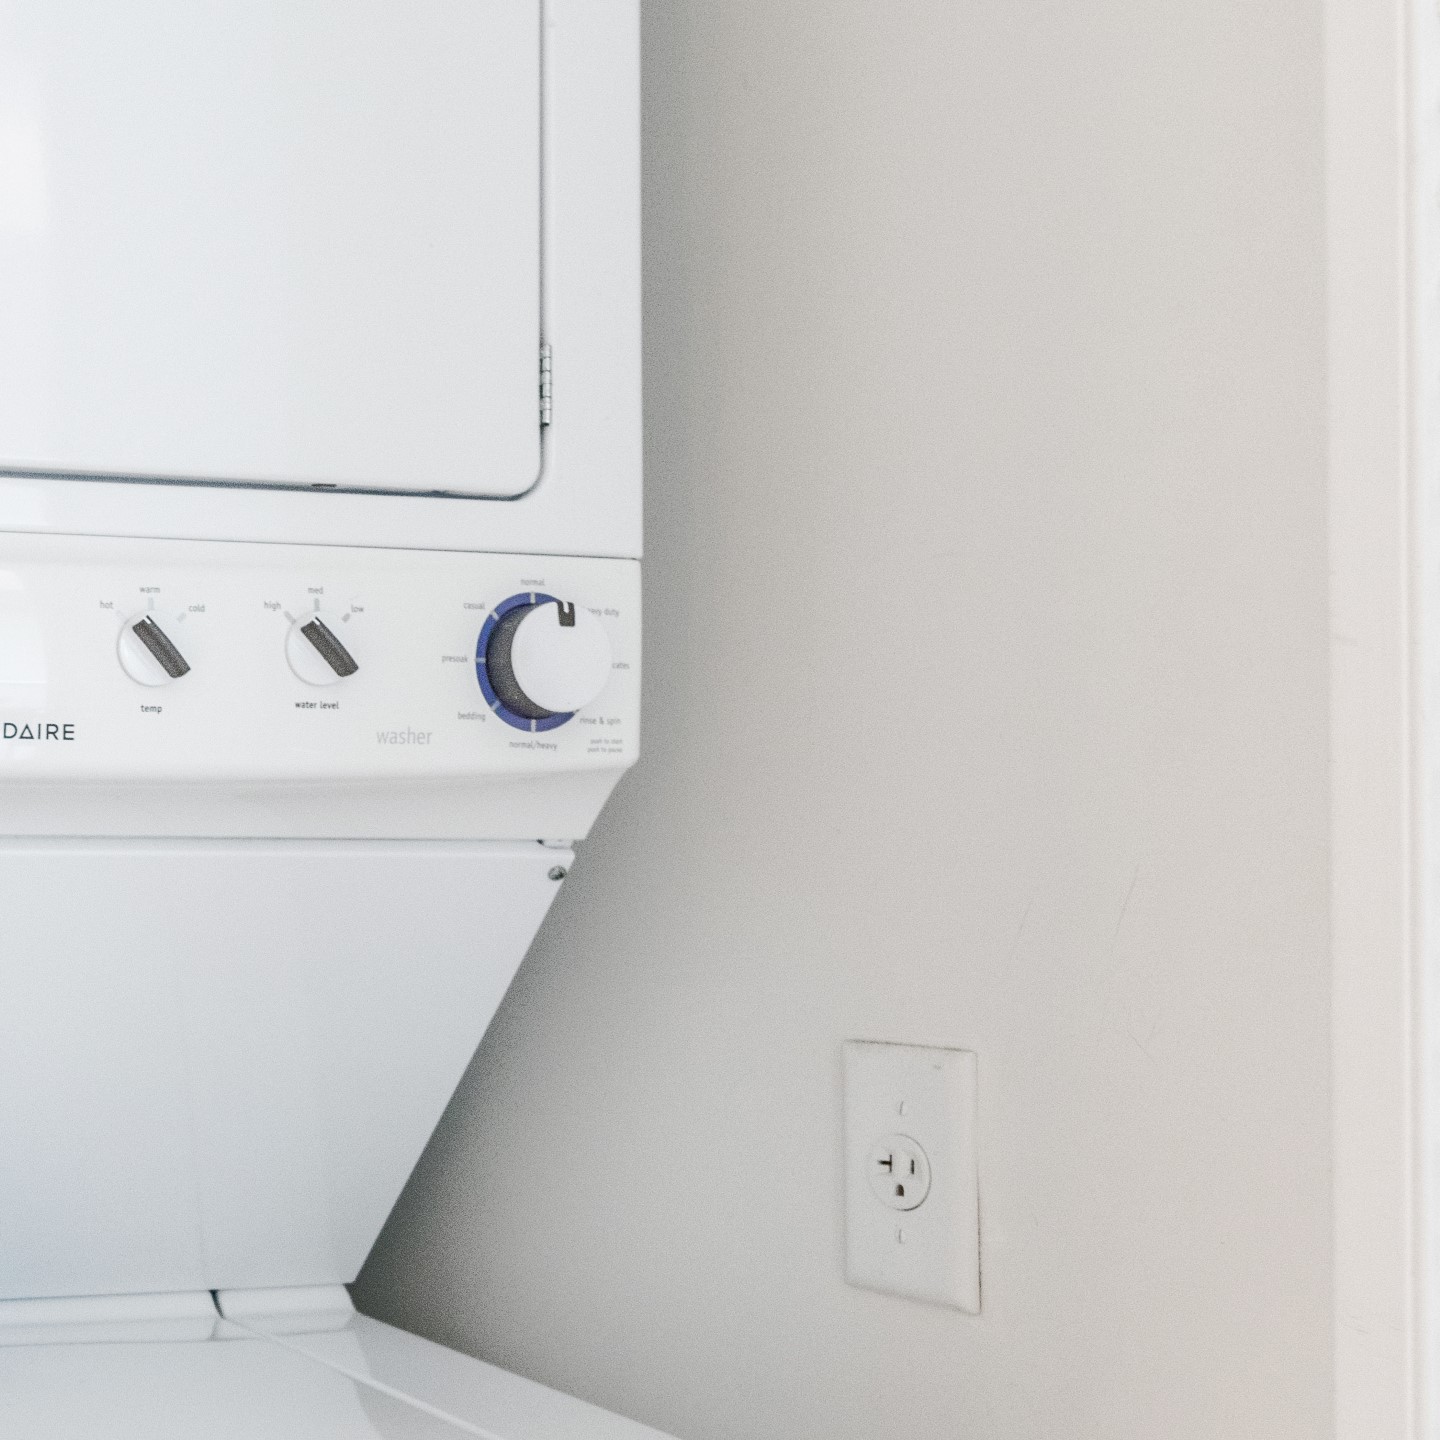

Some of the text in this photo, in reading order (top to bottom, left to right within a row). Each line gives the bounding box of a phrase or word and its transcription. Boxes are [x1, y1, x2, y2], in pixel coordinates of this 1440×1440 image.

[520, 578, 545, 586] normal
[139, 586, 161, 594] warm
[308, 586, 324, 595] med
[100, 600, 114, 610] hot
[188, 603, 206, 613] cold
[264, 601, 281, 612] high
[351, 604, 365, 613] low
[463, 601, 486, 610] casual
[140, 705, 163, 715] temp
[295, 701, 340, 710] water level
[457, 711, 486, 722] bedding
[376, 725, 433, 745] washer
